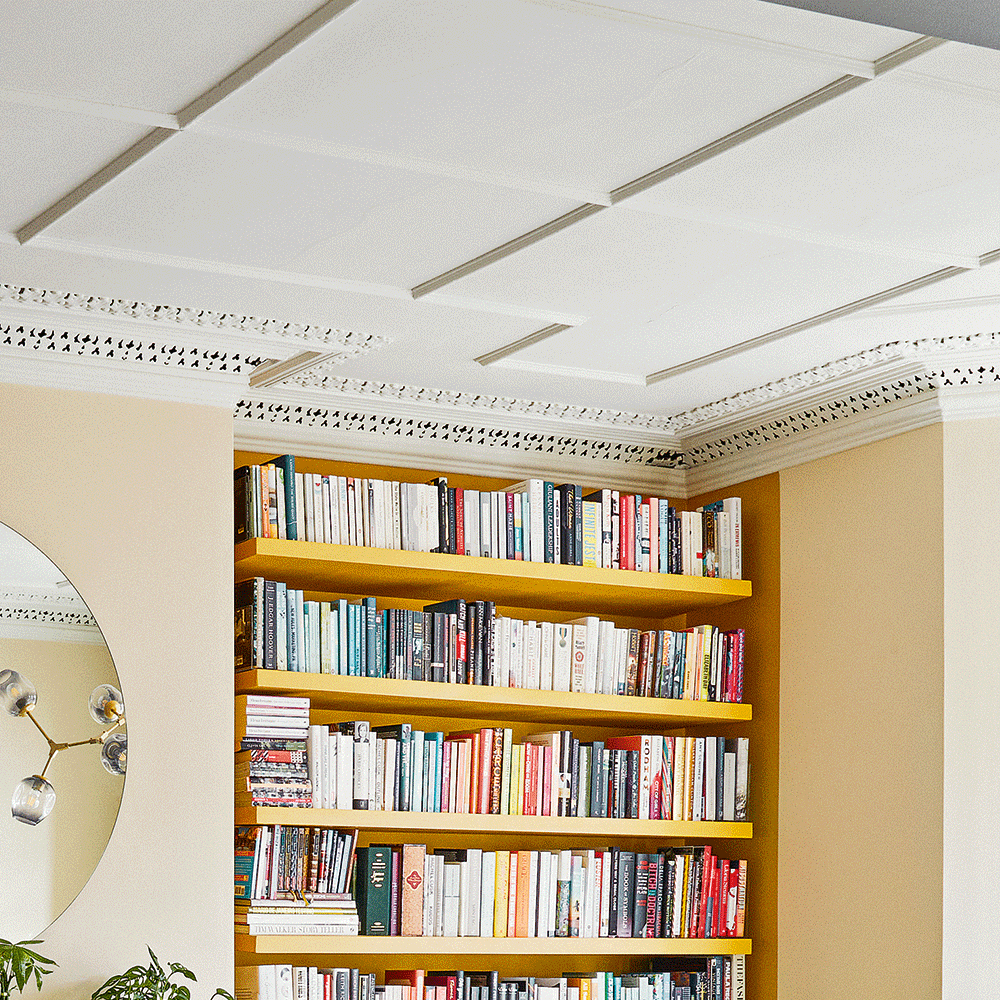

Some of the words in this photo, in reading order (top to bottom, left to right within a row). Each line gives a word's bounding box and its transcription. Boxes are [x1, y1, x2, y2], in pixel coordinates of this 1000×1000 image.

[584, 503, 596, 538] INFINITE
[584, 540, 596, 560] JEST
[649, 862, 657, 890] BITCH
